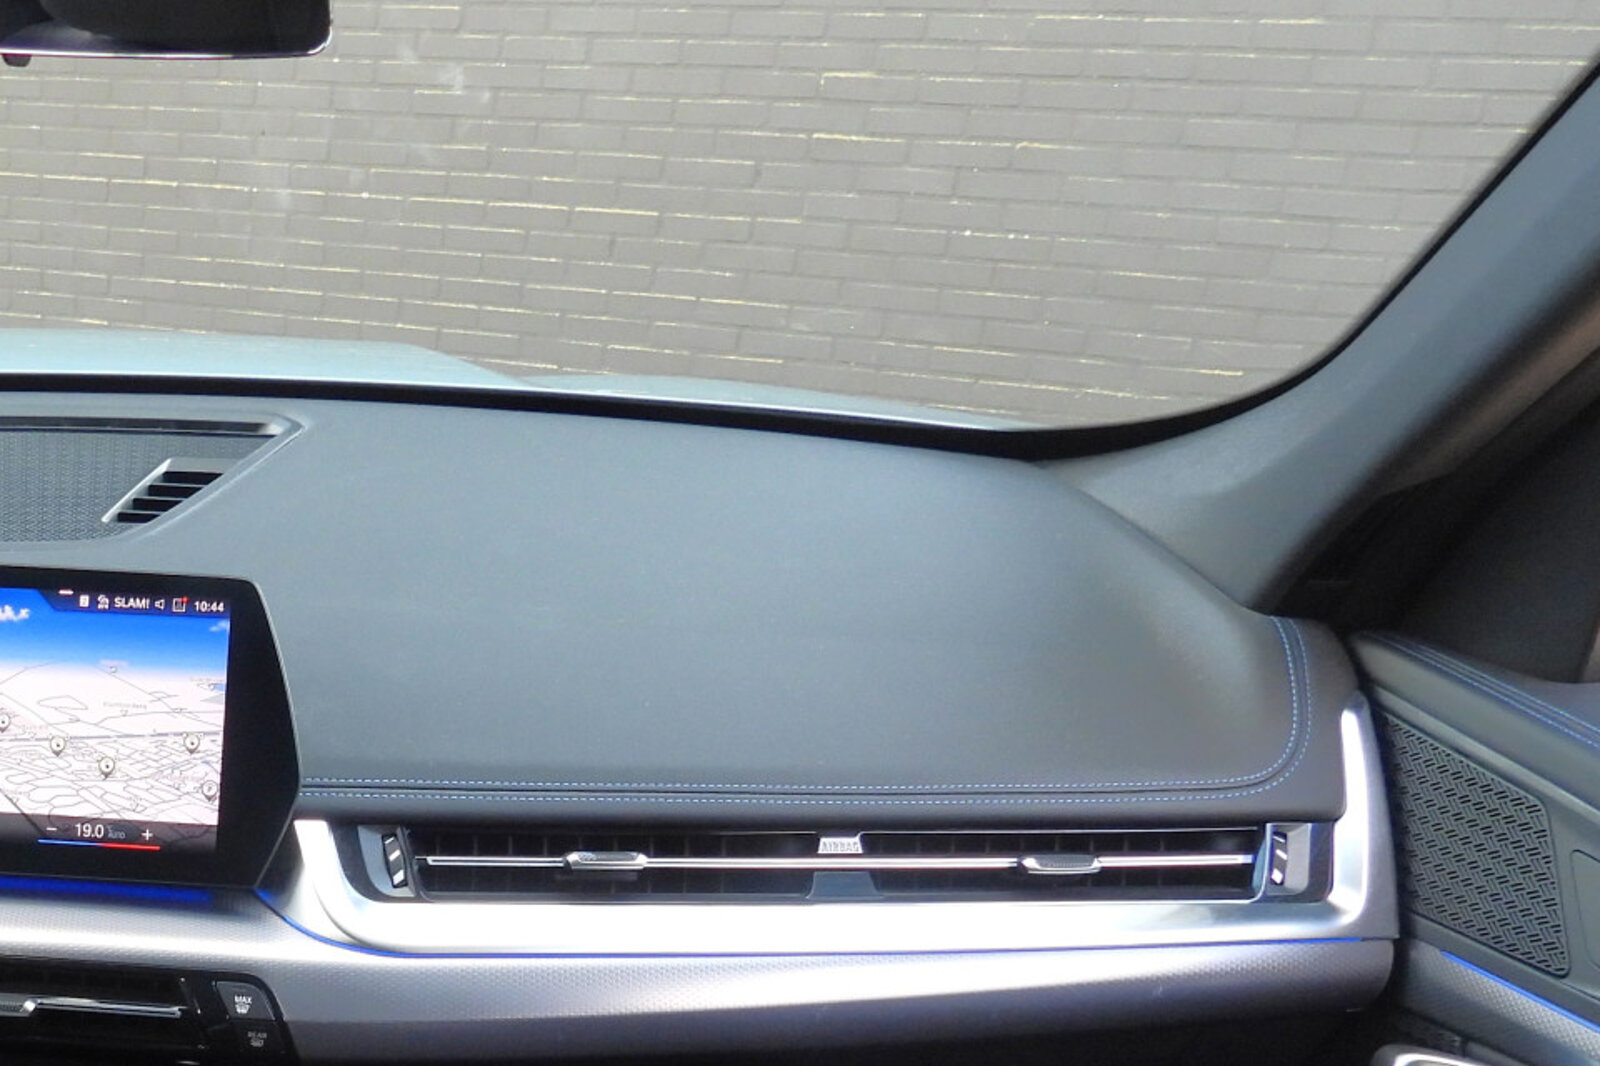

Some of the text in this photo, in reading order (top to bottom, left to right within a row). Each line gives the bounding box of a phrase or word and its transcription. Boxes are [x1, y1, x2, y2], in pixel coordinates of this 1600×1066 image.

[114, 596, 149, 609] SLAM!
[194, 600, 224, 612] 10:44
[75, 823, 104, 838] 19.0
[821, 840, 859, 852] AIRBAG
[234, 995, 252, 1004] MAX
